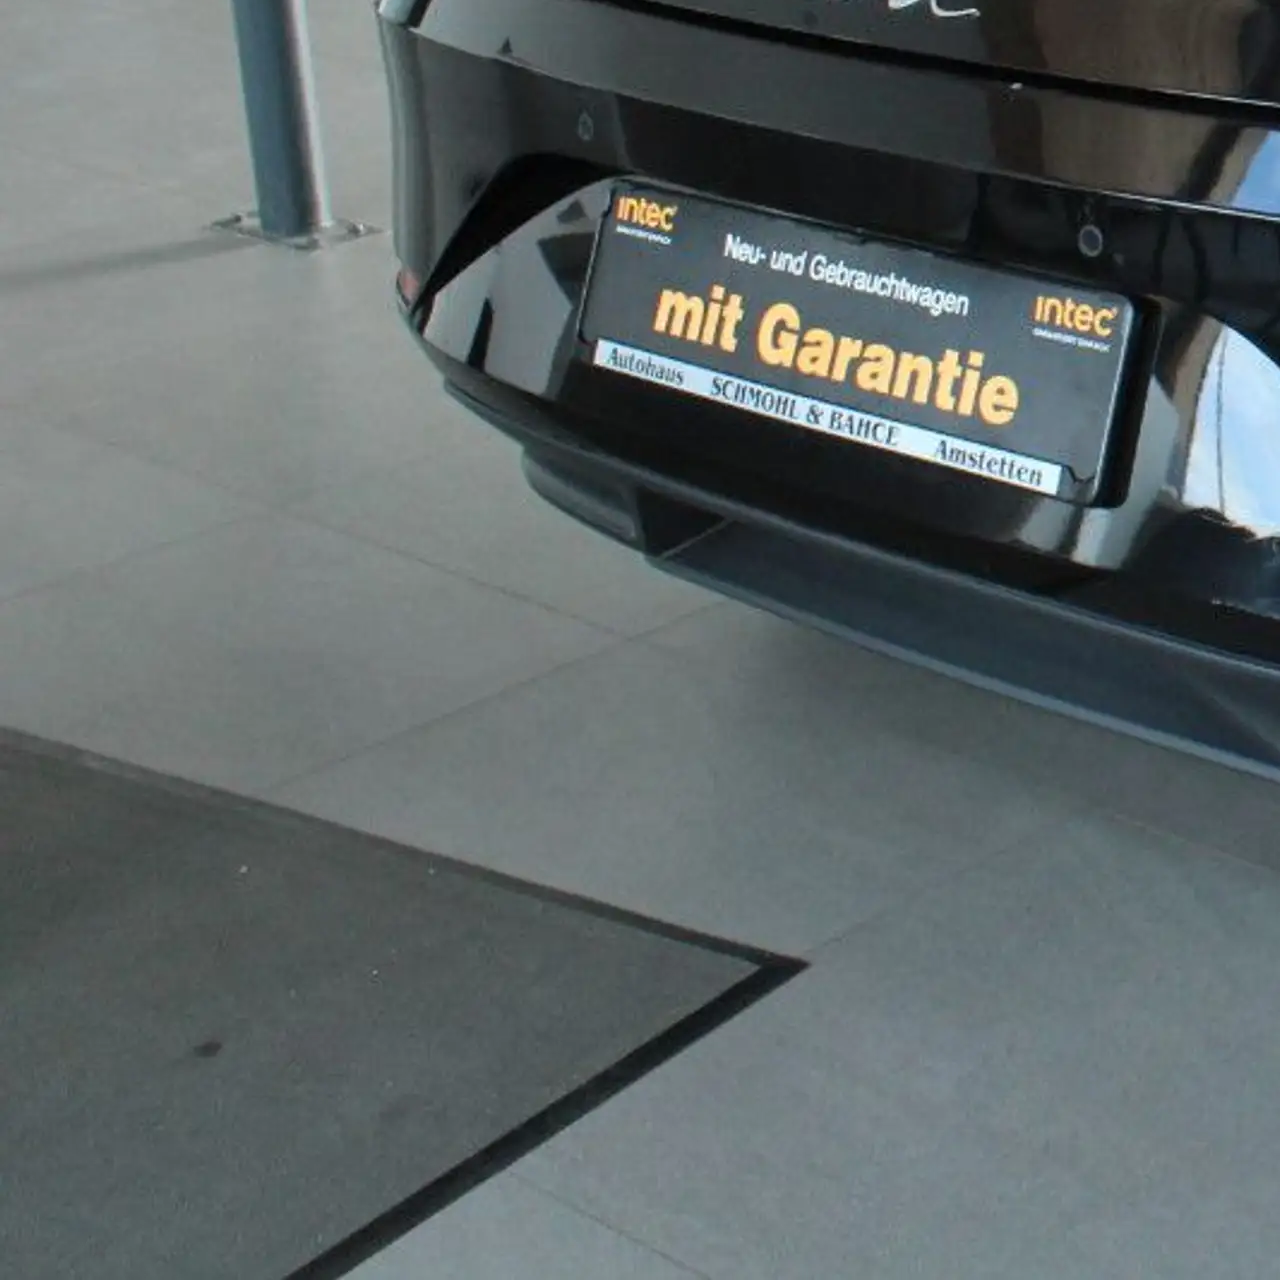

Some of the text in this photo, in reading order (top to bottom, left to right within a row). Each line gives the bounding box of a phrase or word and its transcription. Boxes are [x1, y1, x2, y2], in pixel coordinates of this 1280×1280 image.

[616, 195, 678, 232] intec
[723, 233, 970, 317] Neu- und Gebrauchtwagen
[1033, 295, 1119, 338] intec
[653, 283, 1020, 426] mit Garantie
[606, 346, 685, 388] Autohaus
[710, 376, 801, 421] SCHMOHL
[805, 403, 826, 426] &
[932, 438, 1044, 488] Amstetten
